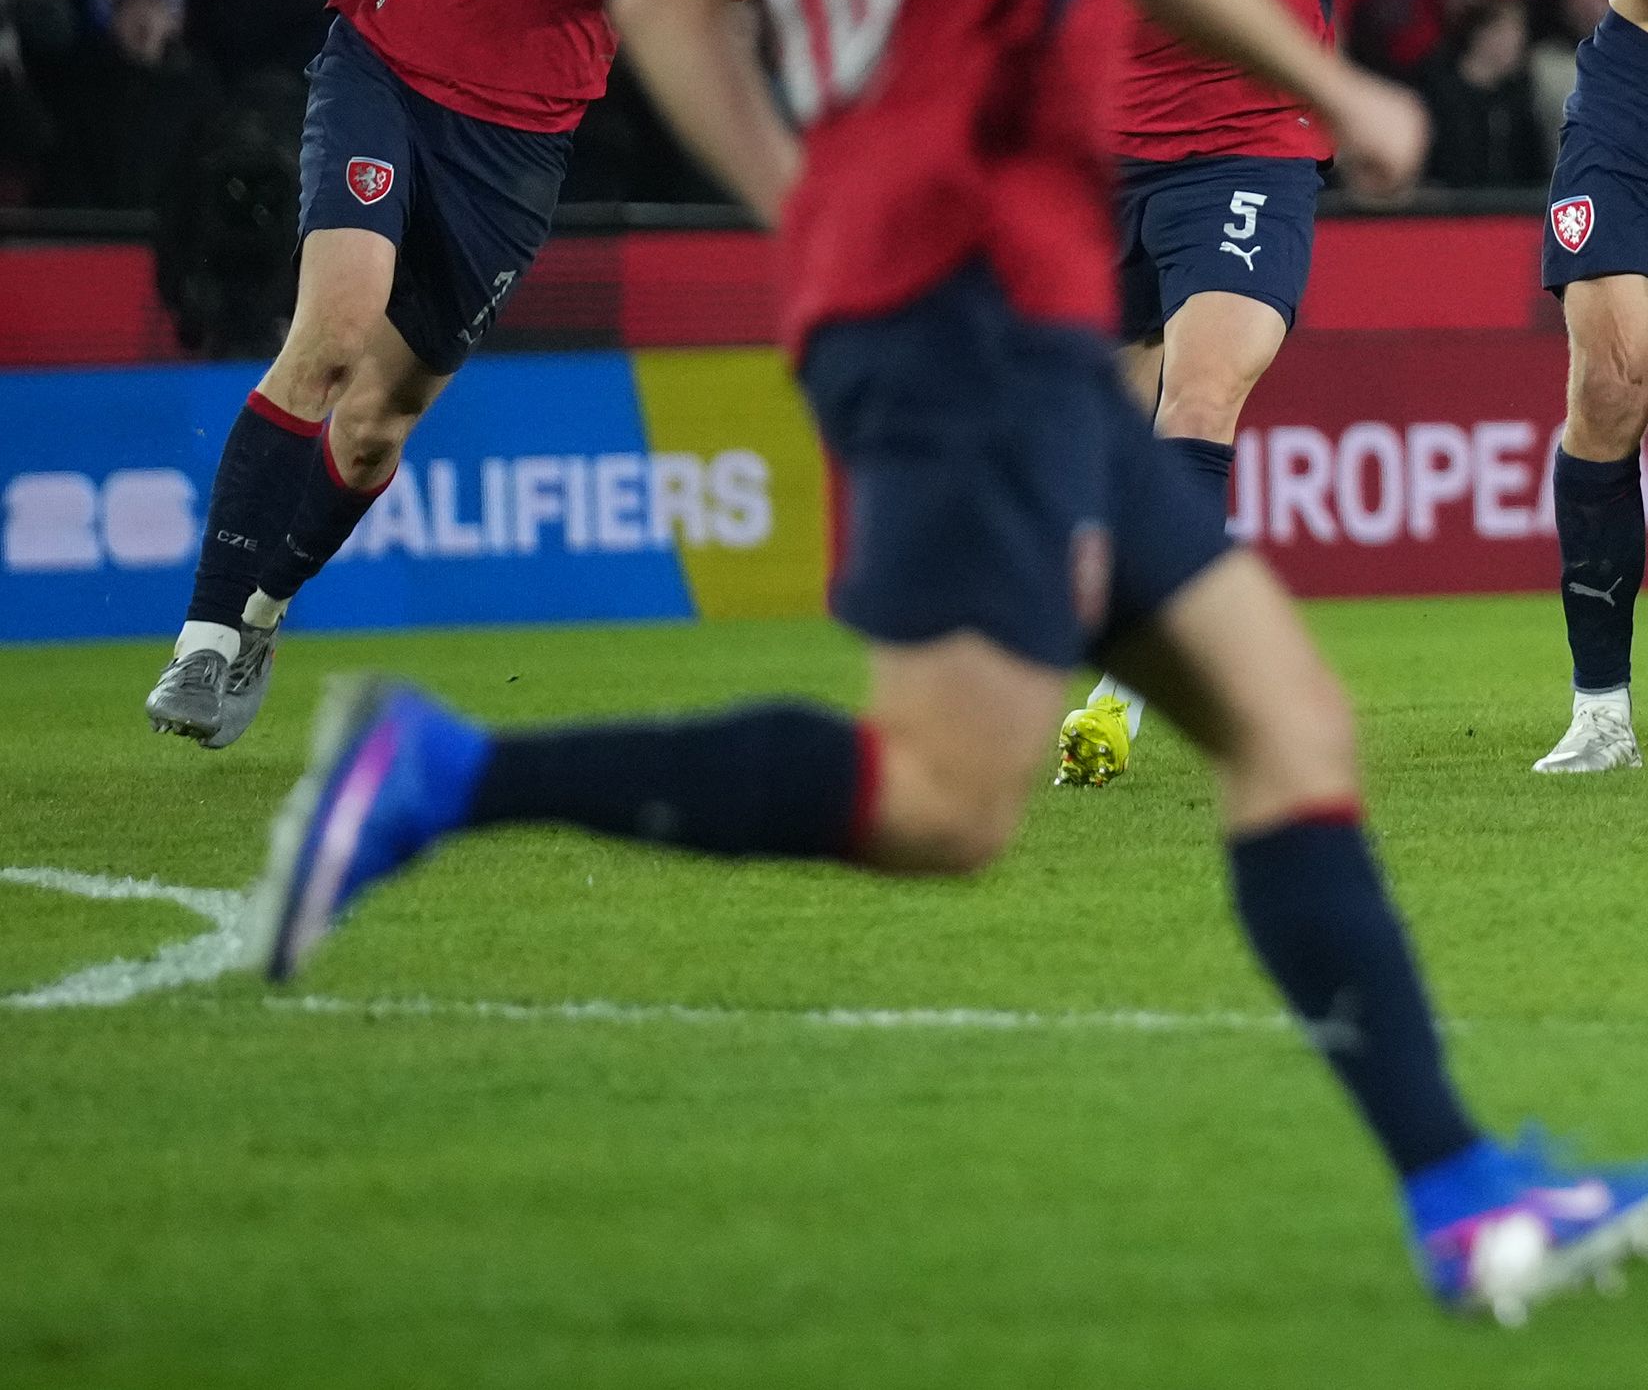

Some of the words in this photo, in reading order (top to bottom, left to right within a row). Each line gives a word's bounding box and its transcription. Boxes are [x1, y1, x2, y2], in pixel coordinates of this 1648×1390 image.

[1223, 191, 1268, 240] 5
[338, 452, 772, 558] ALIFIERS
[217, 529, 258, 552] CZE
